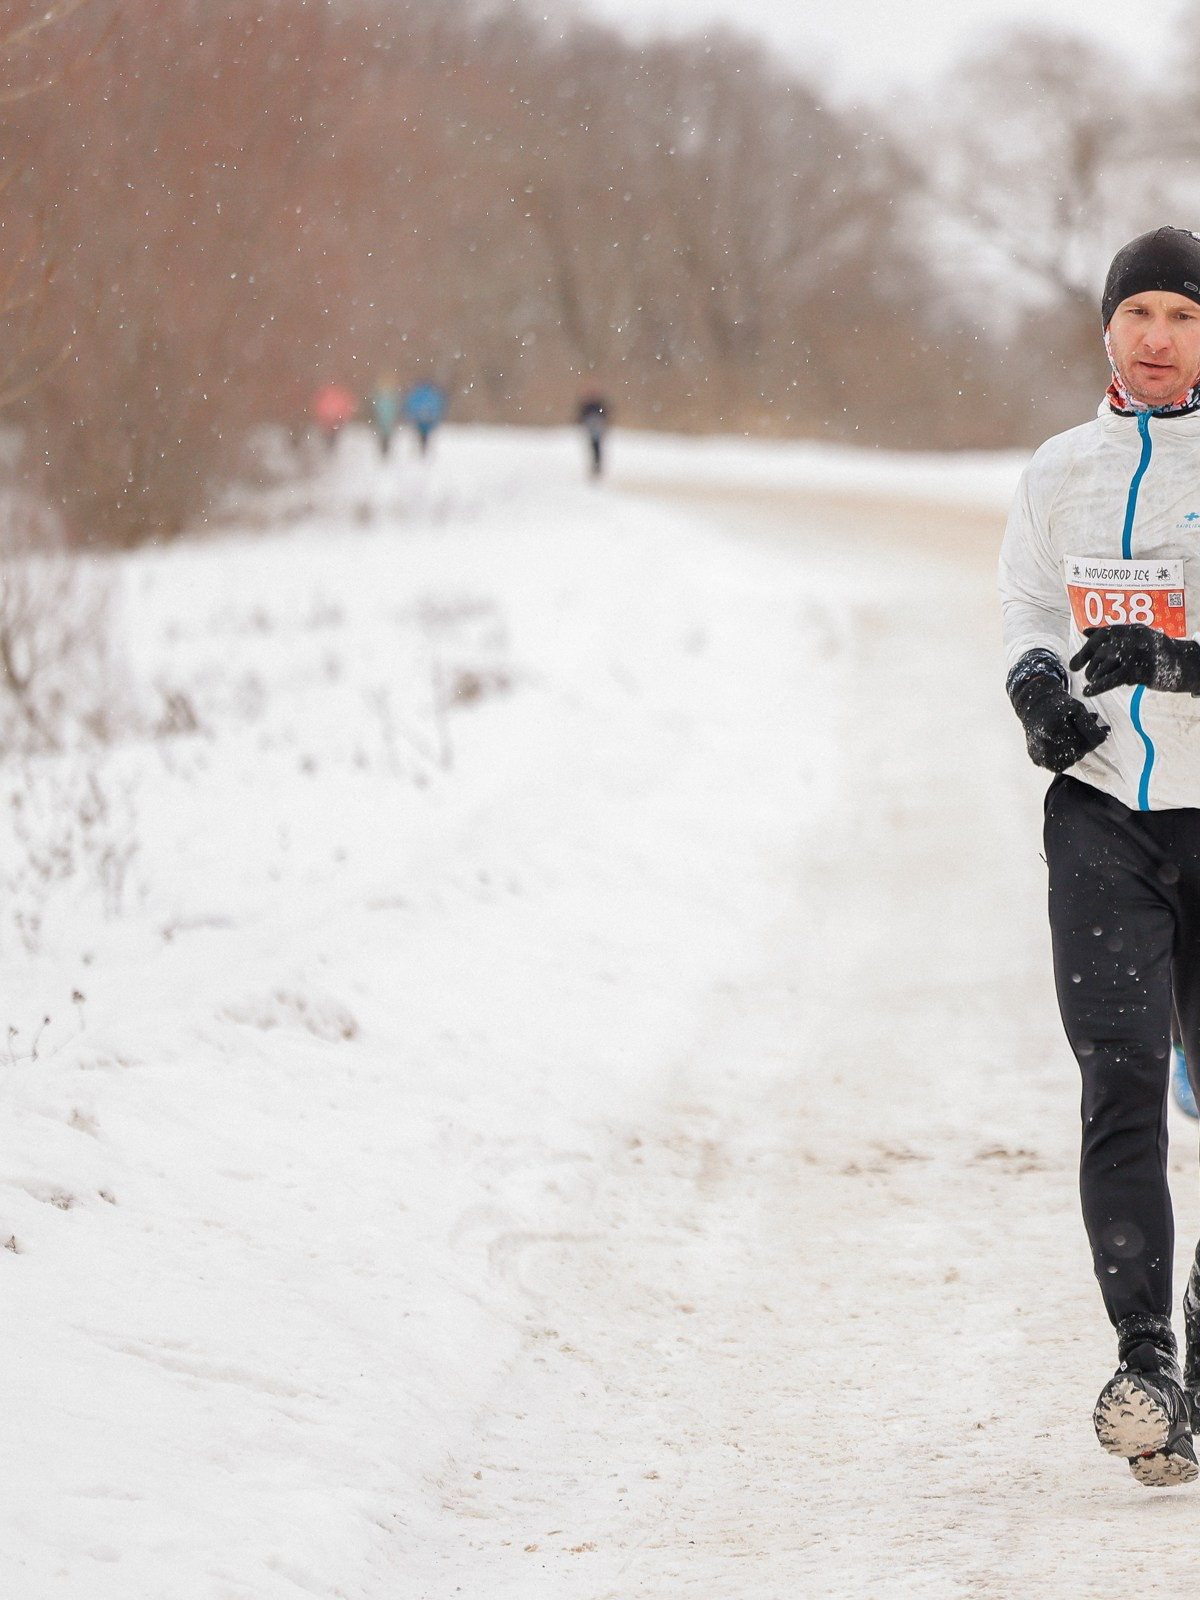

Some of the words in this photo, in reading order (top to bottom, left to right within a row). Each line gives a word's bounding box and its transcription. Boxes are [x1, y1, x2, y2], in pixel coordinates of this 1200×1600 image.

[1085, 566, 1131, 581] NOVGOROD
[1133, 567, 1150, 581] ICE
[1084, 591, 1155, 627] 038
